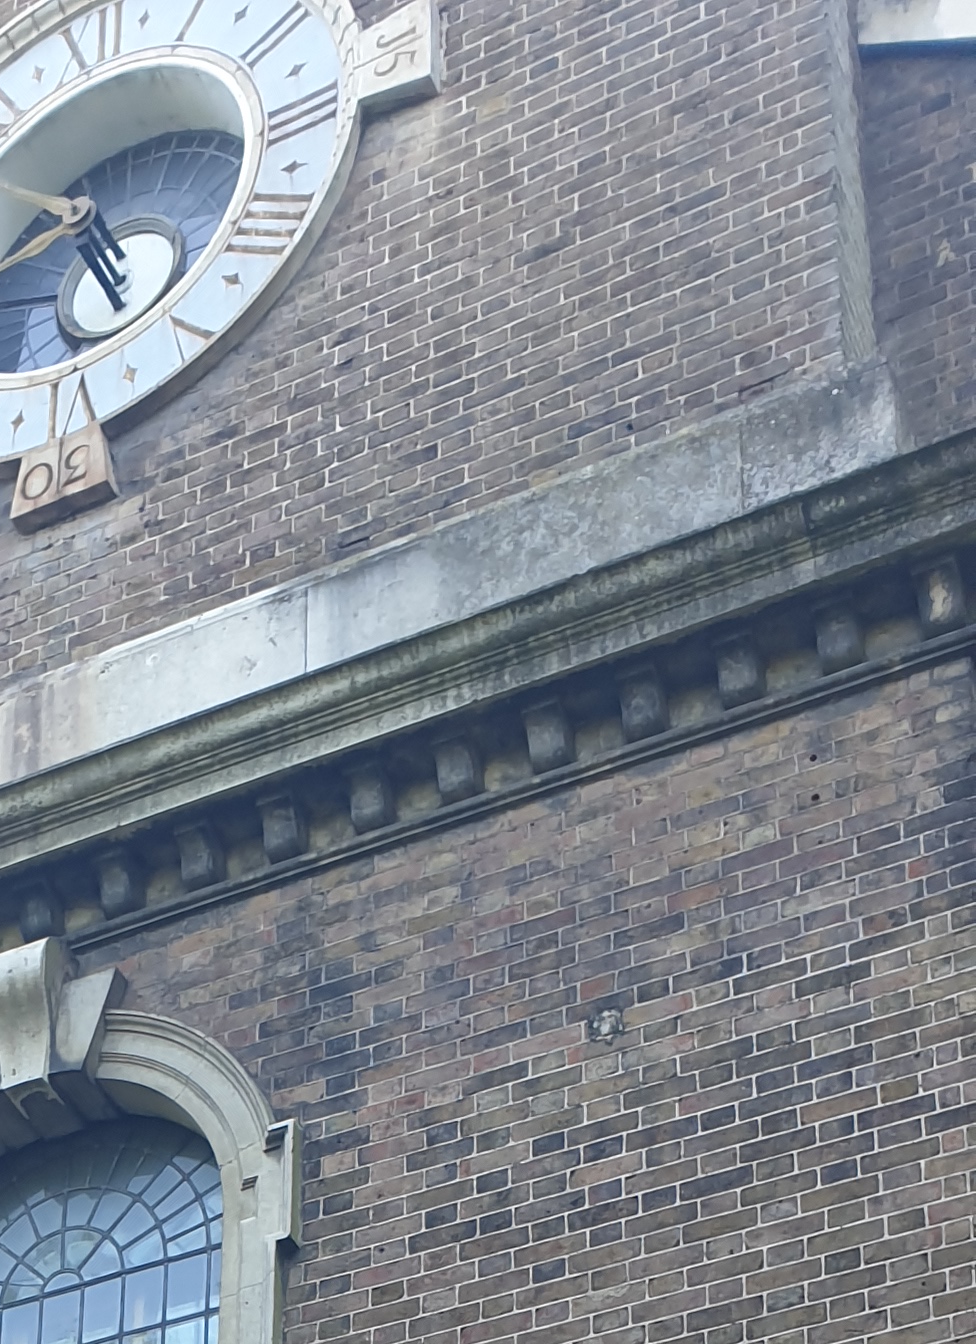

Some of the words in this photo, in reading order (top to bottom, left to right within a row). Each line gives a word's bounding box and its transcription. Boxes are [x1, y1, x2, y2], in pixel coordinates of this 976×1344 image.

[239, 1, 312, 69] II
[266, 77, 338, 150] III
[223, 192, 315, 256] IIII
[22, 443, 90, 500] 30
